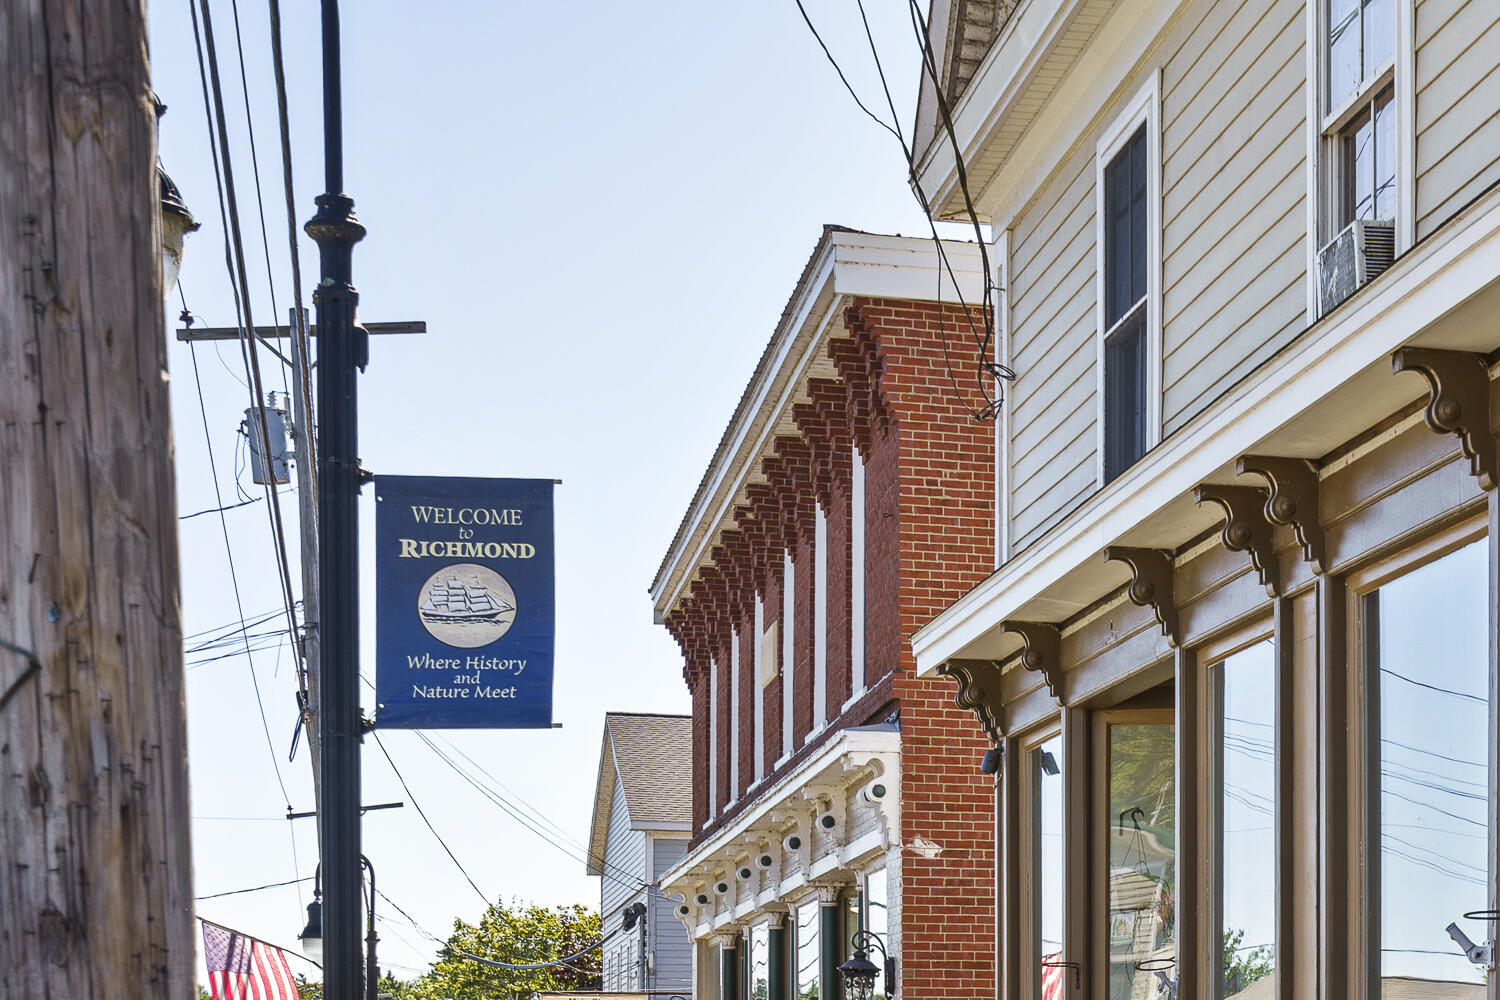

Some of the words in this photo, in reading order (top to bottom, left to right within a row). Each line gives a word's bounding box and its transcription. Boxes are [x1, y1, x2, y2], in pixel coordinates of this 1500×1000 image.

[411, 506, 523, 526] WELCOME
[459, 526, 474, 539] to
[399, 538, 536, 559] RICHMOND
[406, 653, 461, 670] Where
[466, 655, 527, 676] History
[453, 670, 480, 684] and
[412, 685, 470, 699] Nature
[474, 686, 518, 699] Meet
